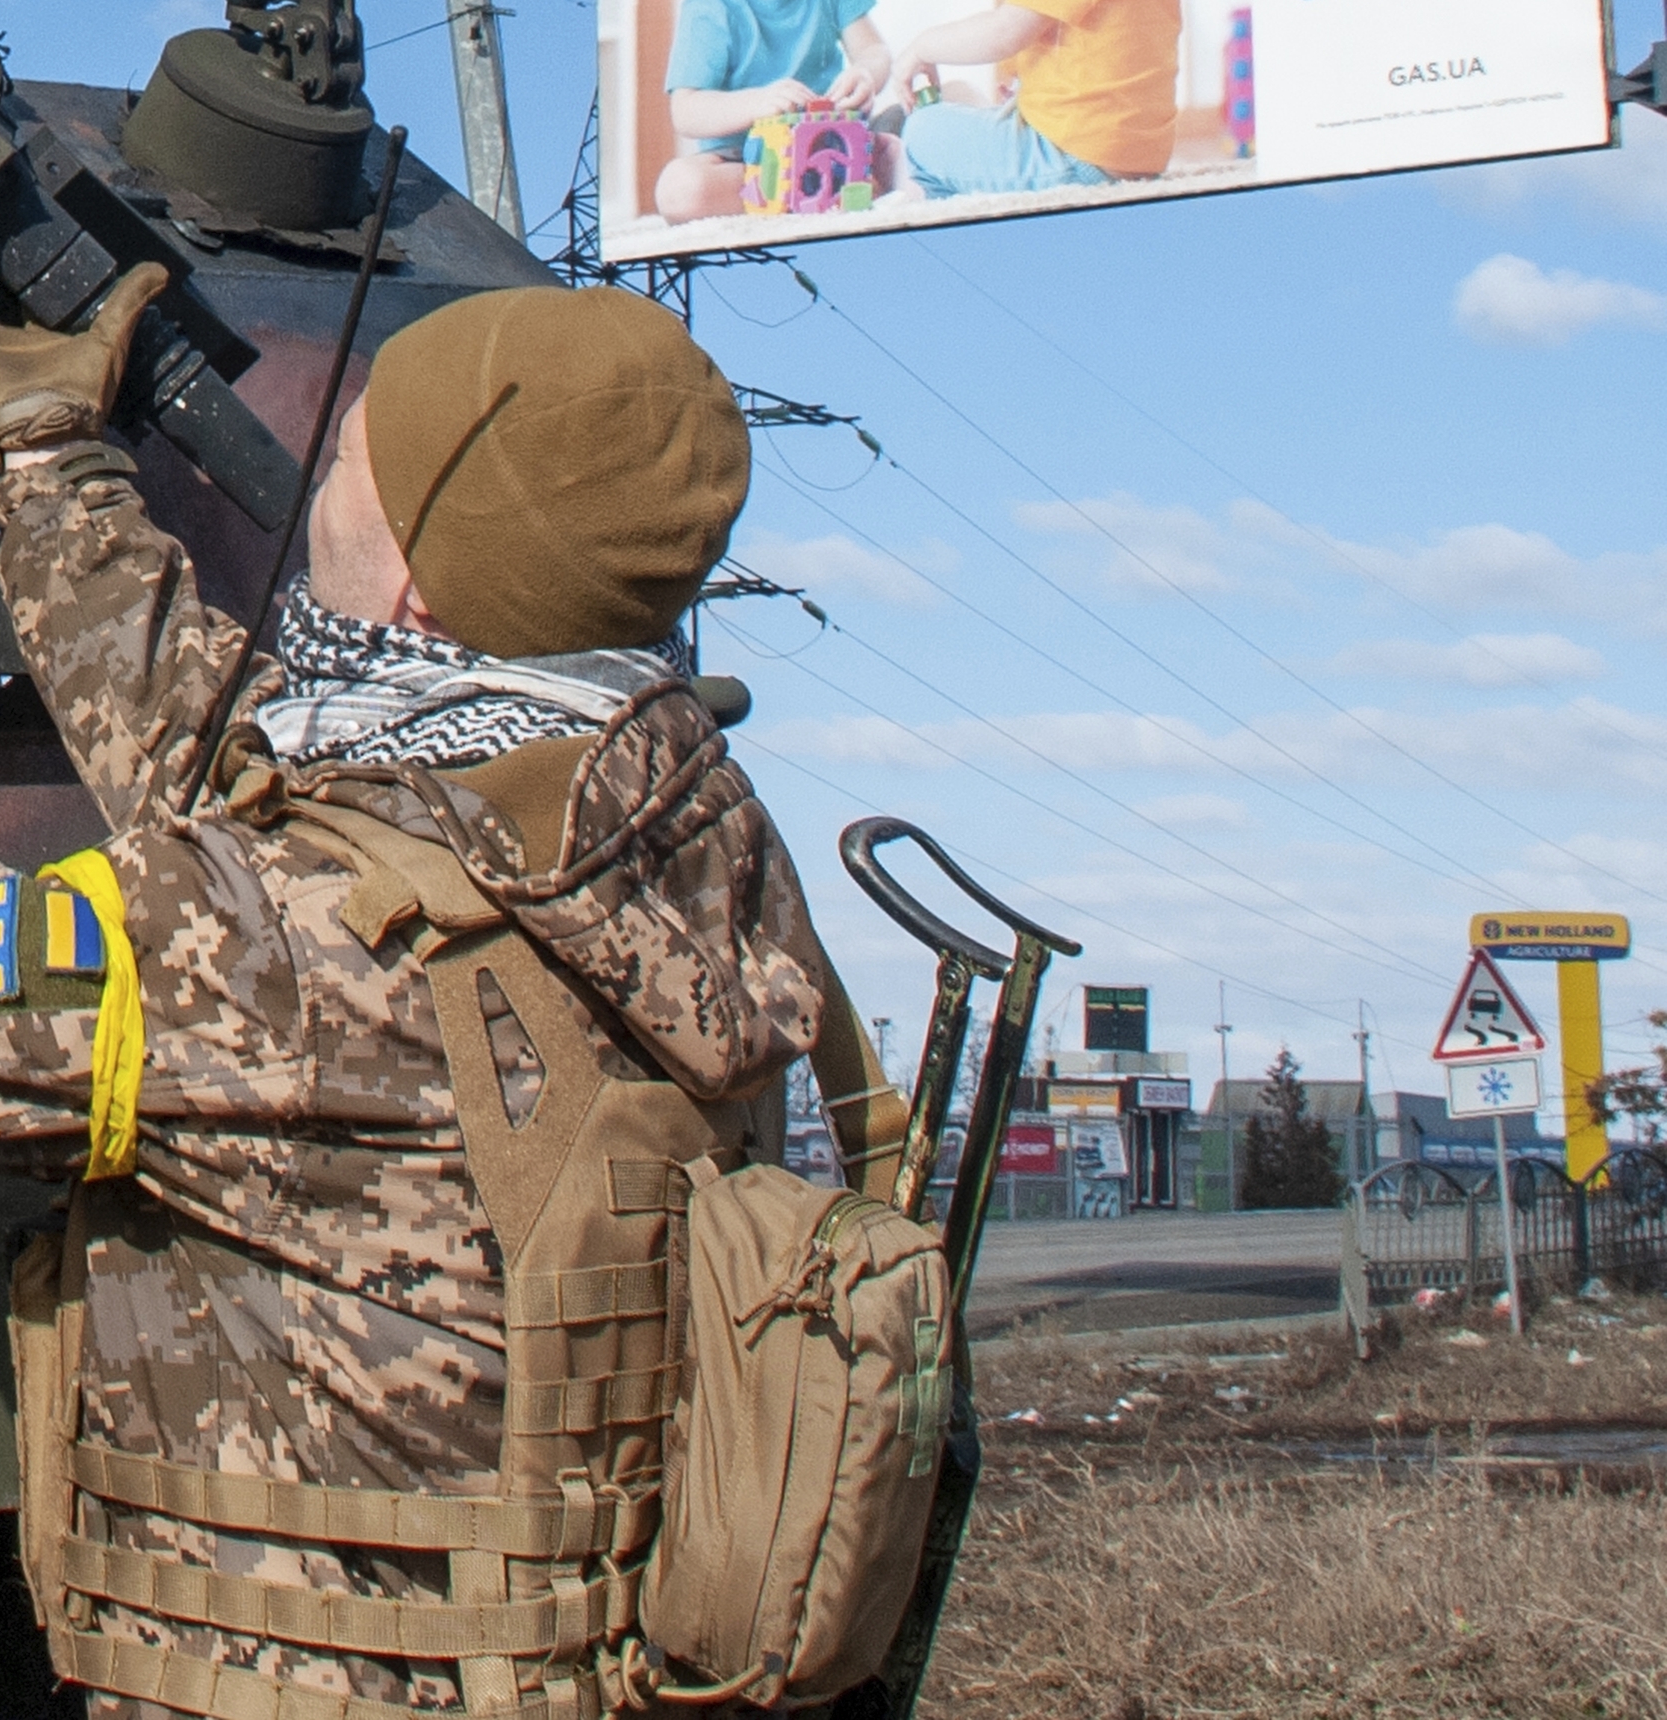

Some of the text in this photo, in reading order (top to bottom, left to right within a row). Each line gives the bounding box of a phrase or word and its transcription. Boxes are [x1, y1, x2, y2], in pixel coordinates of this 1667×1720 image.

[1388, 57, 1486, 86] GAS.UA
[1506, 925, 1615, 937] NEW HOLLAND
